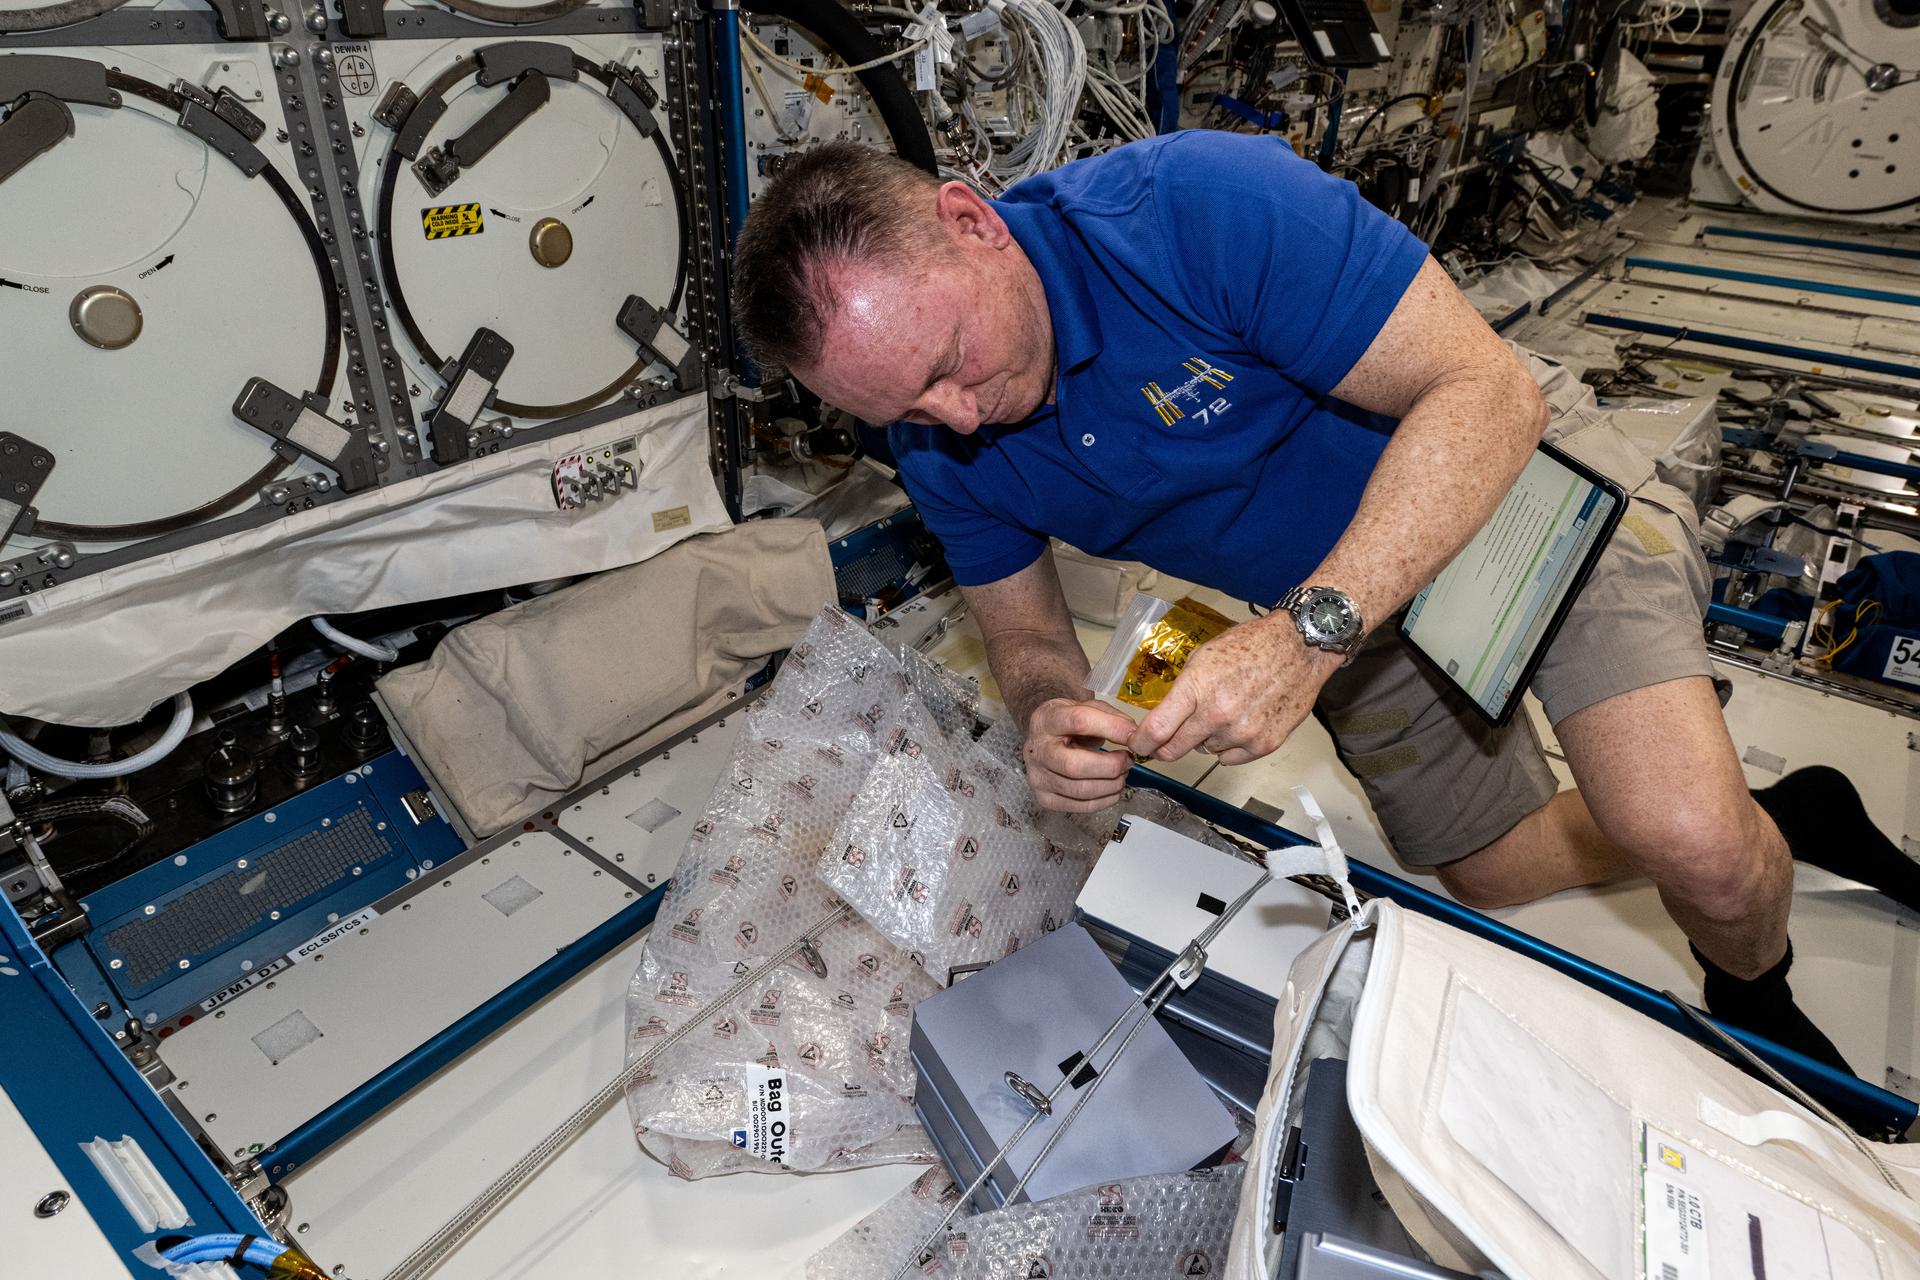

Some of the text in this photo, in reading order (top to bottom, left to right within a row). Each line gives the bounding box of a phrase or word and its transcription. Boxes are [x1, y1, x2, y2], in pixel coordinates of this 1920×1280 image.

[334, 45, 362, 54] DEWAR
[359, 62, 365, 70] B
[351, 82, 357, 90] C
[571, 205, 583, 215] OPEN
[430, 213, 458, 221] WARNING
[505, 214, 521, 223] CLOSE
[138, 266, 157, 280] OPEN
[22, 284, 49, 294] CLOSE
[1191, 397, 1232, 425] 72
[900, 605, 917, 615] EPS
[298, 913, 370, 957] ECLSS/TCS 1
[207, 962, 281, 1008] JPM1 D1
[767, 1078, 782, 1112] Bag
[1690, 1208, 1703, 1230] CTB
